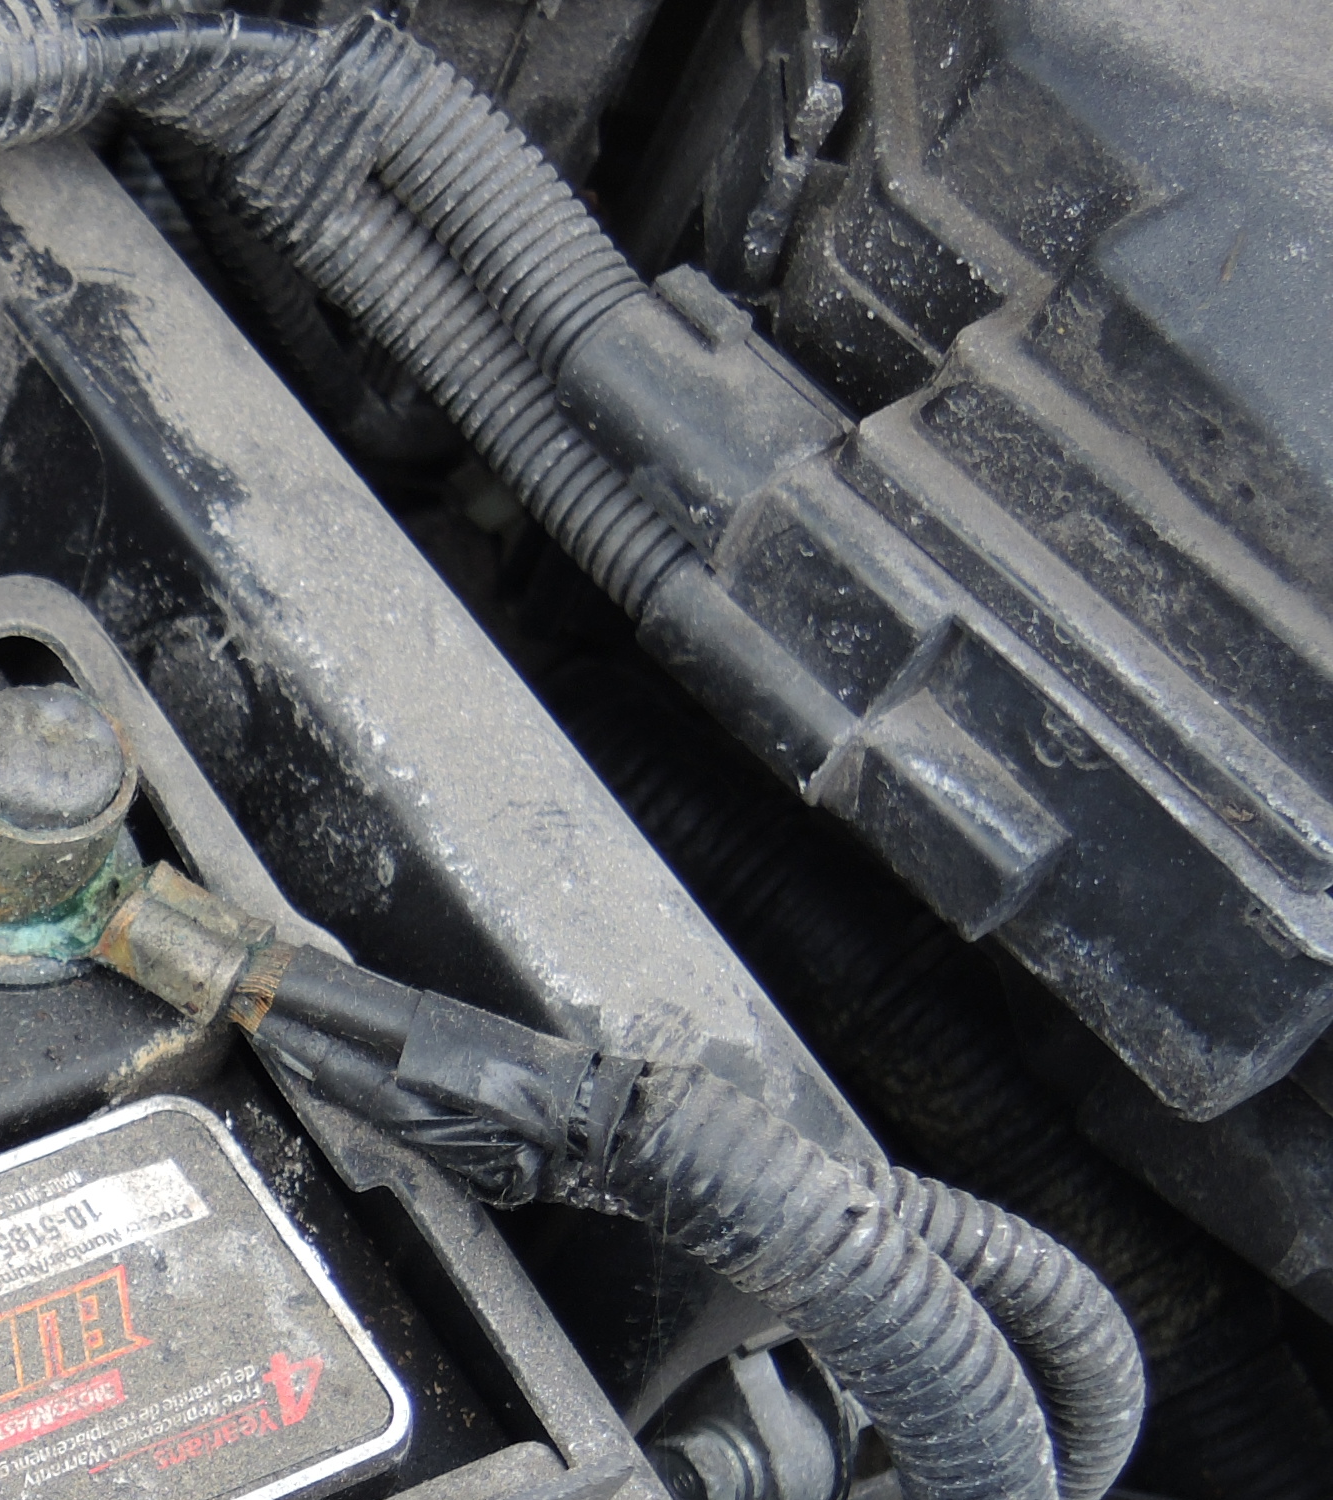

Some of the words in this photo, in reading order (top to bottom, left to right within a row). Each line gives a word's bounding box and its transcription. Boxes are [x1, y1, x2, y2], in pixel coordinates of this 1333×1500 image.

[232, 1364, 259, 1384] de
[218, 1381, 263, 1408] Free
[265, 1353, 326, 1427] 4
[135, 1402, 163, 1423] de
[17, 1442, 107, 1490] Warranty
